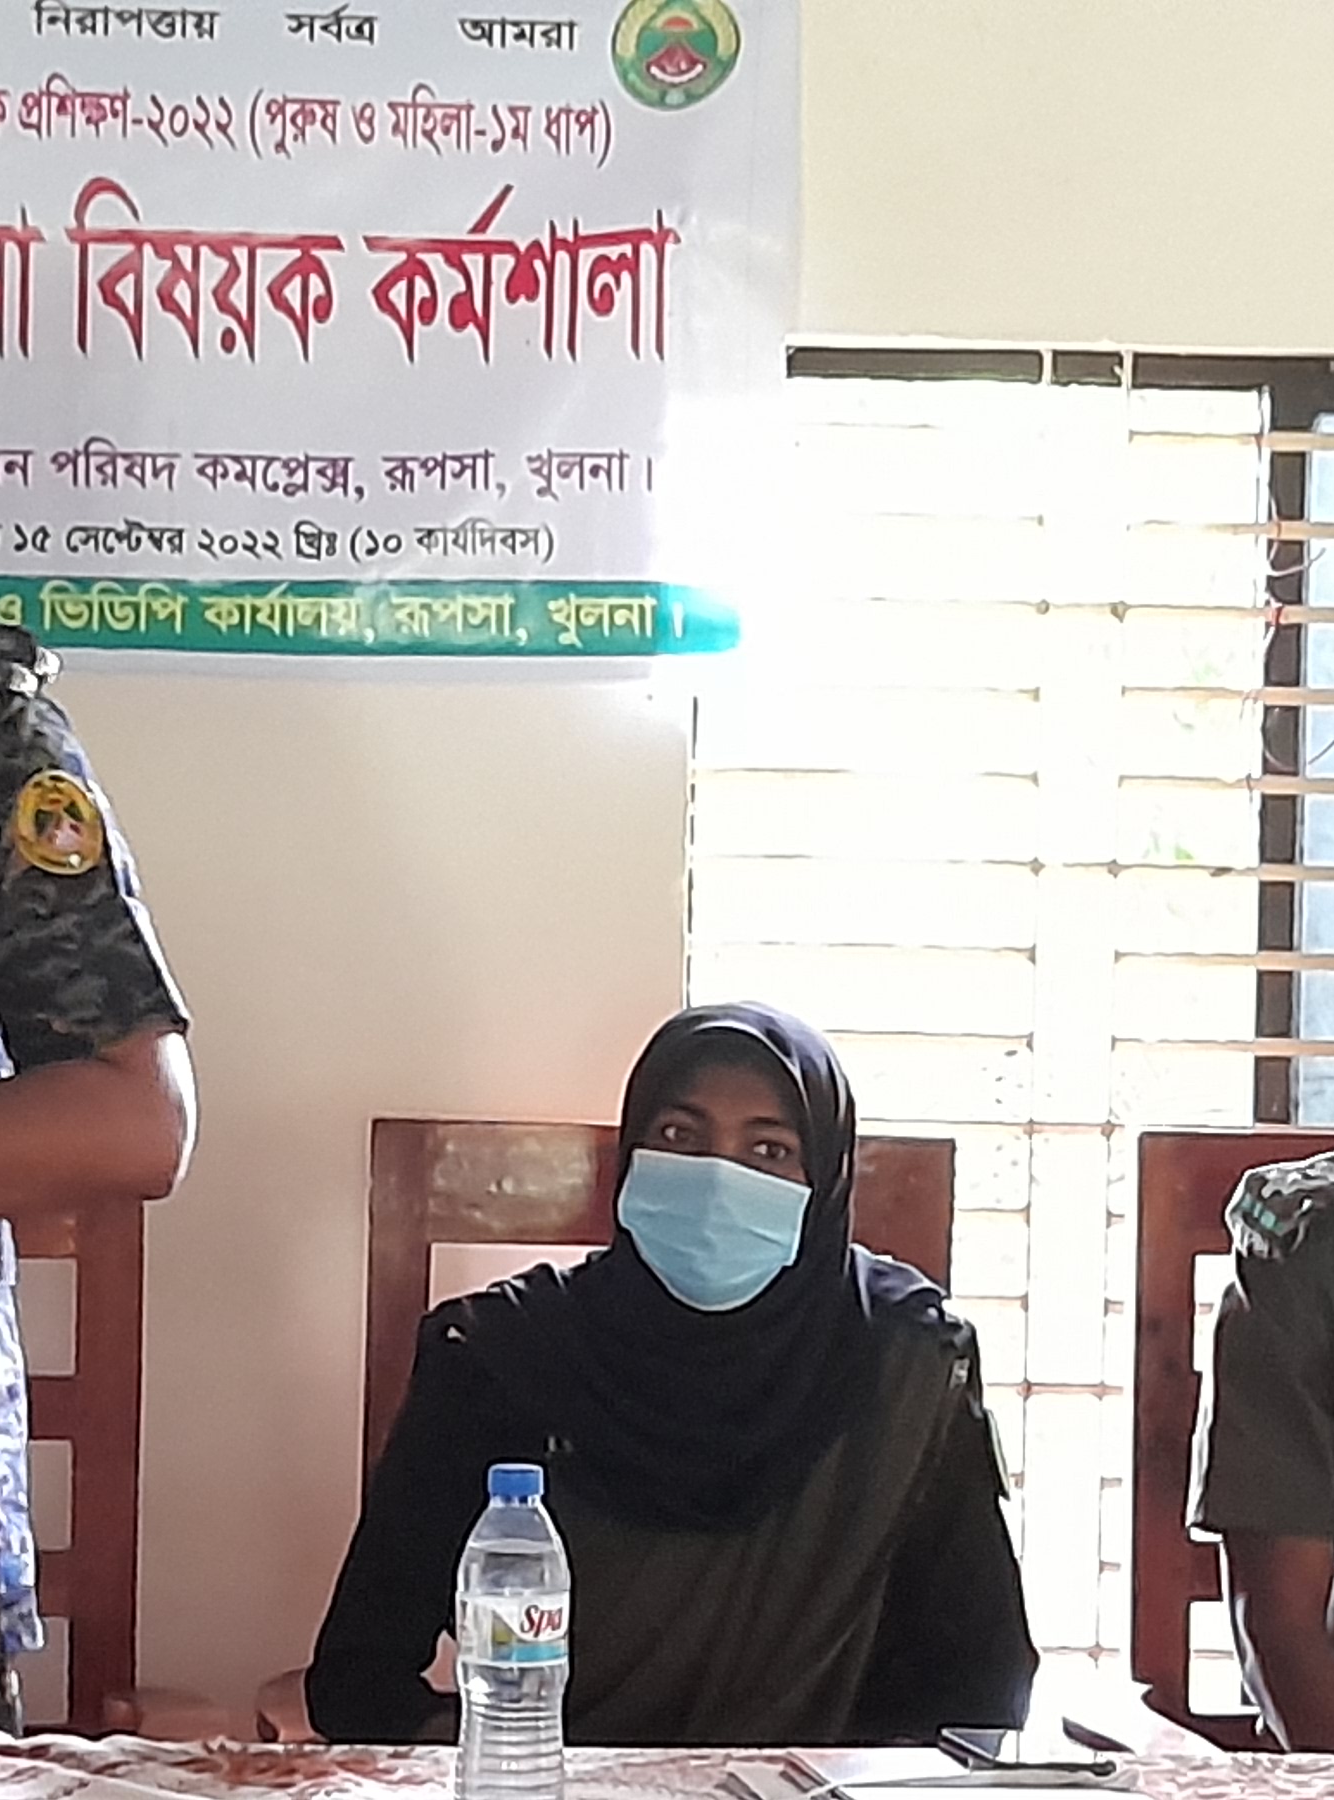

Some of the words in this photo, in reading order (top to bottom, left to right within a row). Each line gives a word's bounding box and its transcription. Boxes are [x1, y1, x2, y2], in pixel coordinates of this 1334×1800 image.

[287, 4, 378, 46] সর্বত্র
[460, 17, 578, 51] আমরা
[351, 101, 377, 146] ও
[64, 176, 345, 364] বিষয়ক
[362, 183, 682, 365] কর্মশালা
[50, 436, 182, 491] পরিষদ
[13, 523, 51, 553] ১৫
[198, 528, 283, 559] ২০২২
[39, 579, 189, 634] ভিডিপি
[519, 1604, 563, 1638] Spa
